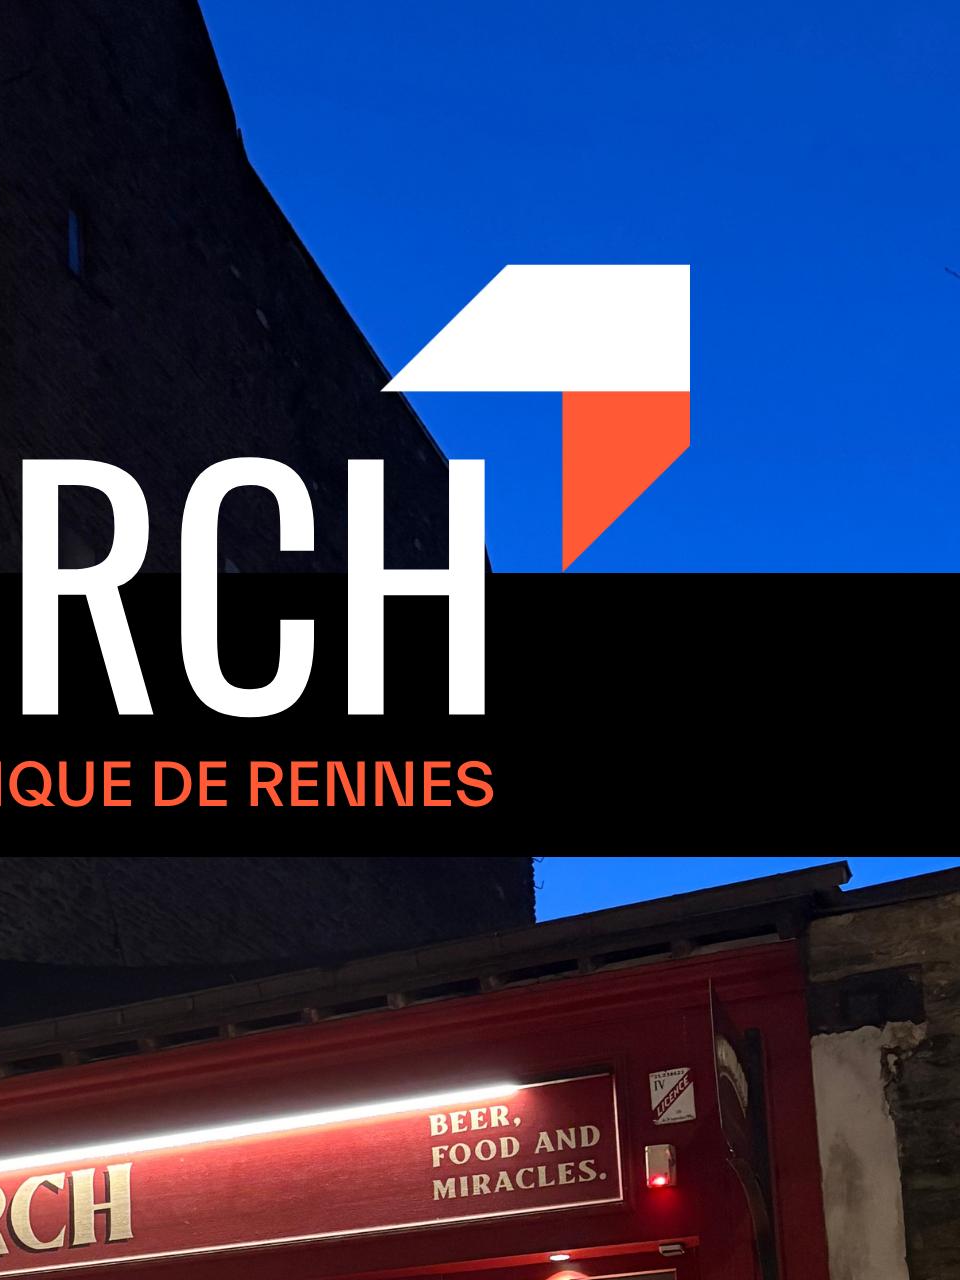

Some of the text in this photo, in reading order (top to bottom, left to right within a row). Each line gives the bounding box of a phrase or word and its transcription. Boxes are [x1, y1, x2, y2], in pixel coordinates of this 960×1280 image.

[656, 1074, 690, 1117] LICENCE
[429, 1105, 522, 1137] BEER,
[431, 1125, 601, 1168] FOOD AND
[433, 1159, 607, 1201] MIRACLES.
